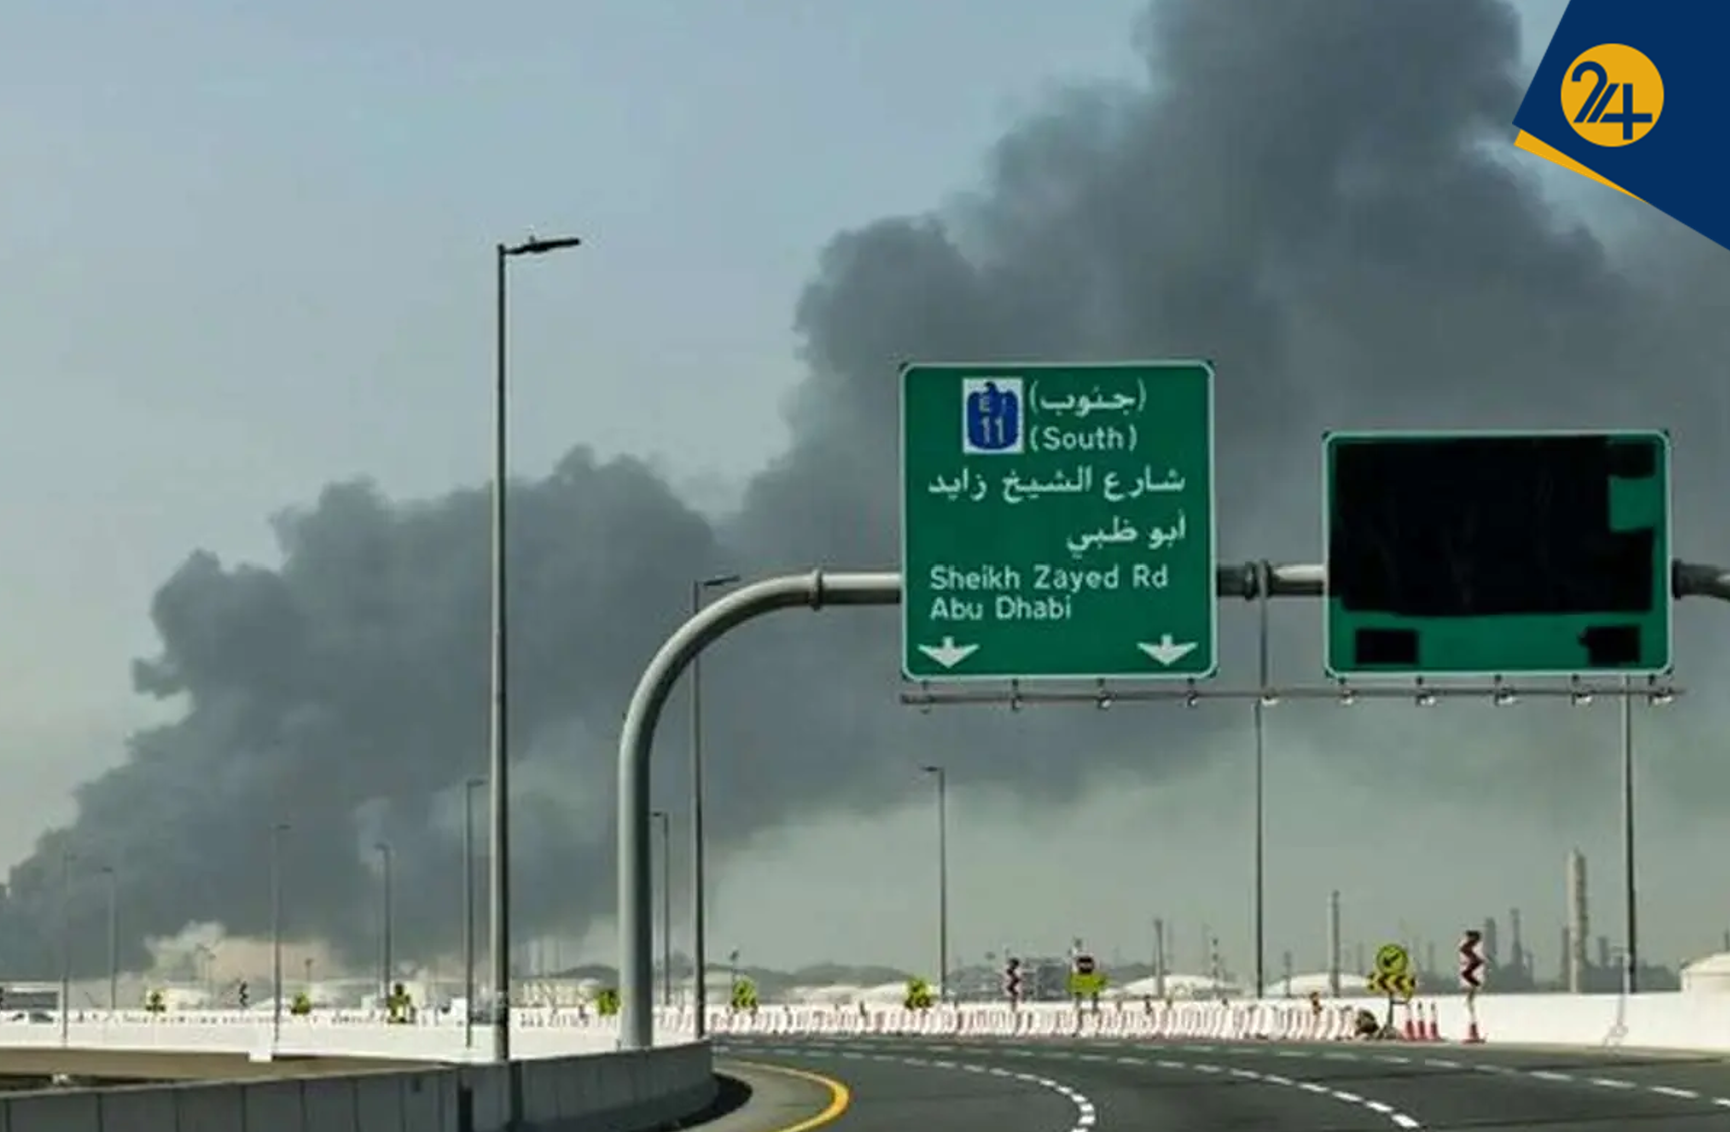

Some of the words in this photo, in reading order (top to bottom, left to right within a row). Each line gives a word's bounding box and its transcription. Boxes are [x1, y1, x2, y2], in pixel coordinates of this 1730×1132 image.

[980, 416, 1005, 446] 11
[1029, 424, 1138, 452] (South)
[927, 467, 987, 501] زايد
[1002, 464, 1092, 503] الشيخ
[1103, 465, 1186, 502] شارع
[1065, 515, 1138, 559] ظبي
[929, 564, 1020, 590] Sheikh
[1033, 564, 1119, 593] Zayed
[1133, 563, 1169, 588] Rd
[929, 596, 983, 620] Abu
[995, 595, 1072, 620] Dhabi
